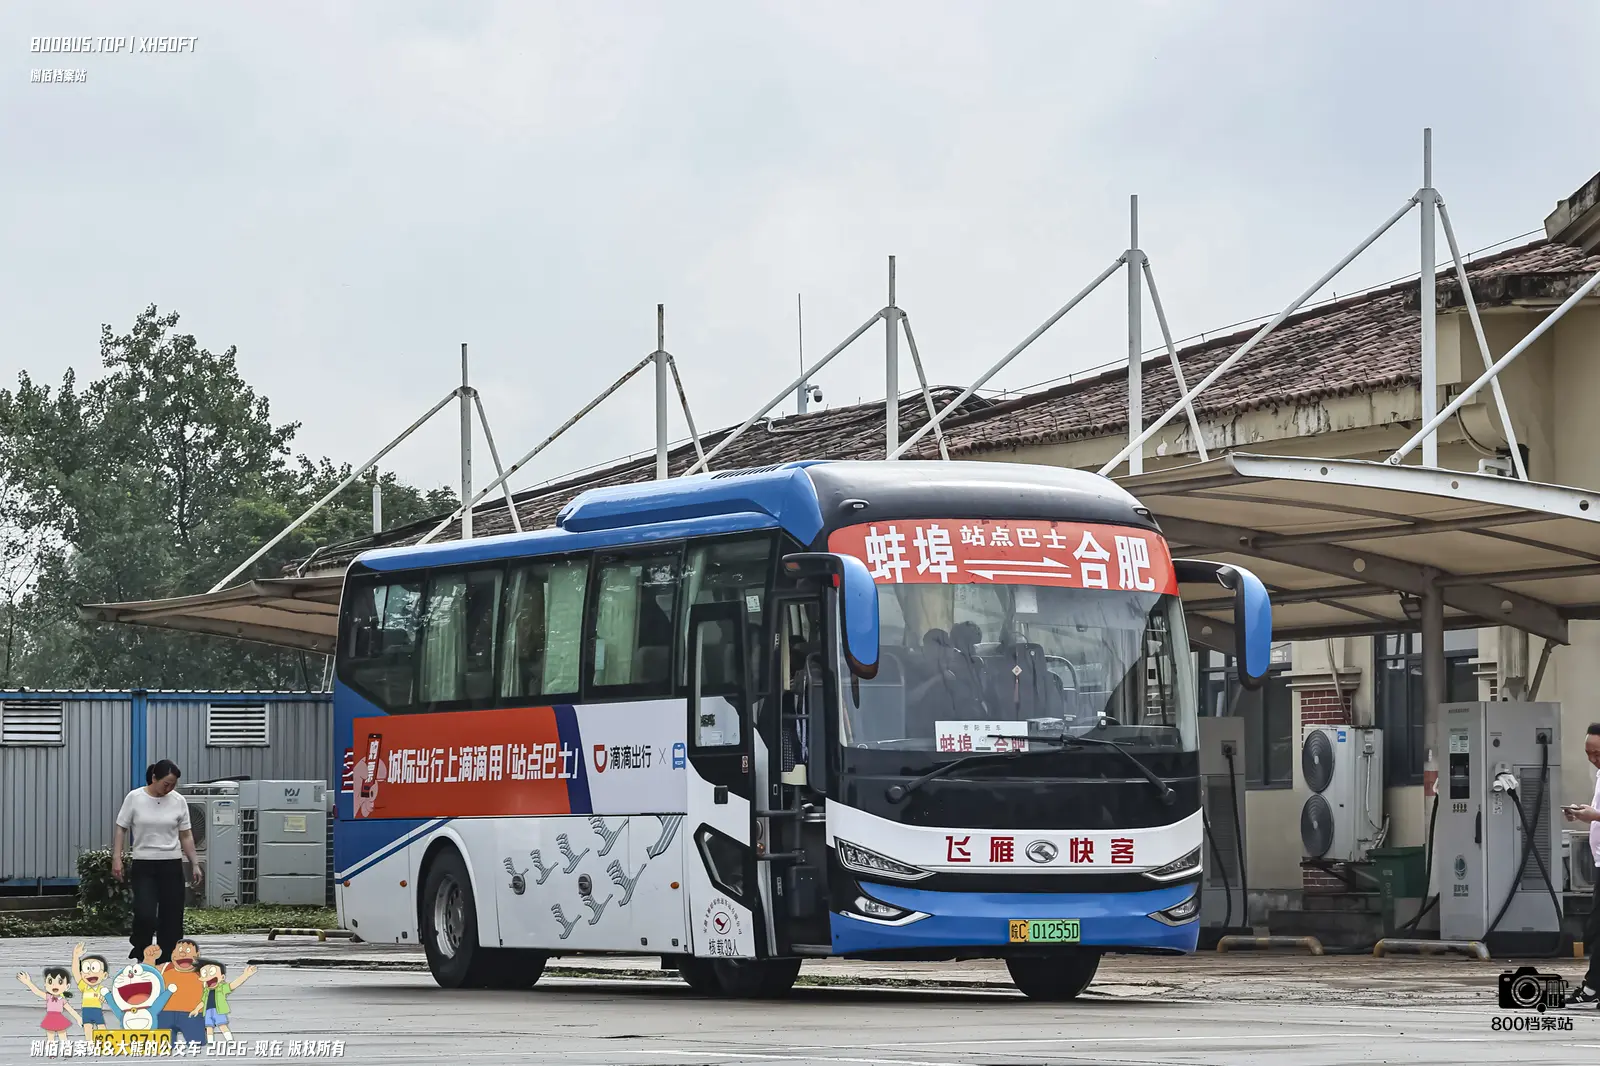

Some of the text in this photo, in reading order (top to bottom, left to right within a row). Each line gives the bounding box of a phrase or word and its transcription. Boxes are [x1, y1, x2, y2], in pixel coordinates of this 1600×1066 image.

[959, 525, 1067, 550] 站点巴士
[864, 523, 1156, 592] 蚌埠 合肥
[939, 733, 973, 752] 蚌埠
[609, 744, 652, 770] 滴滴出行
[945, 835, 1135, 864] 飞雁 快客
